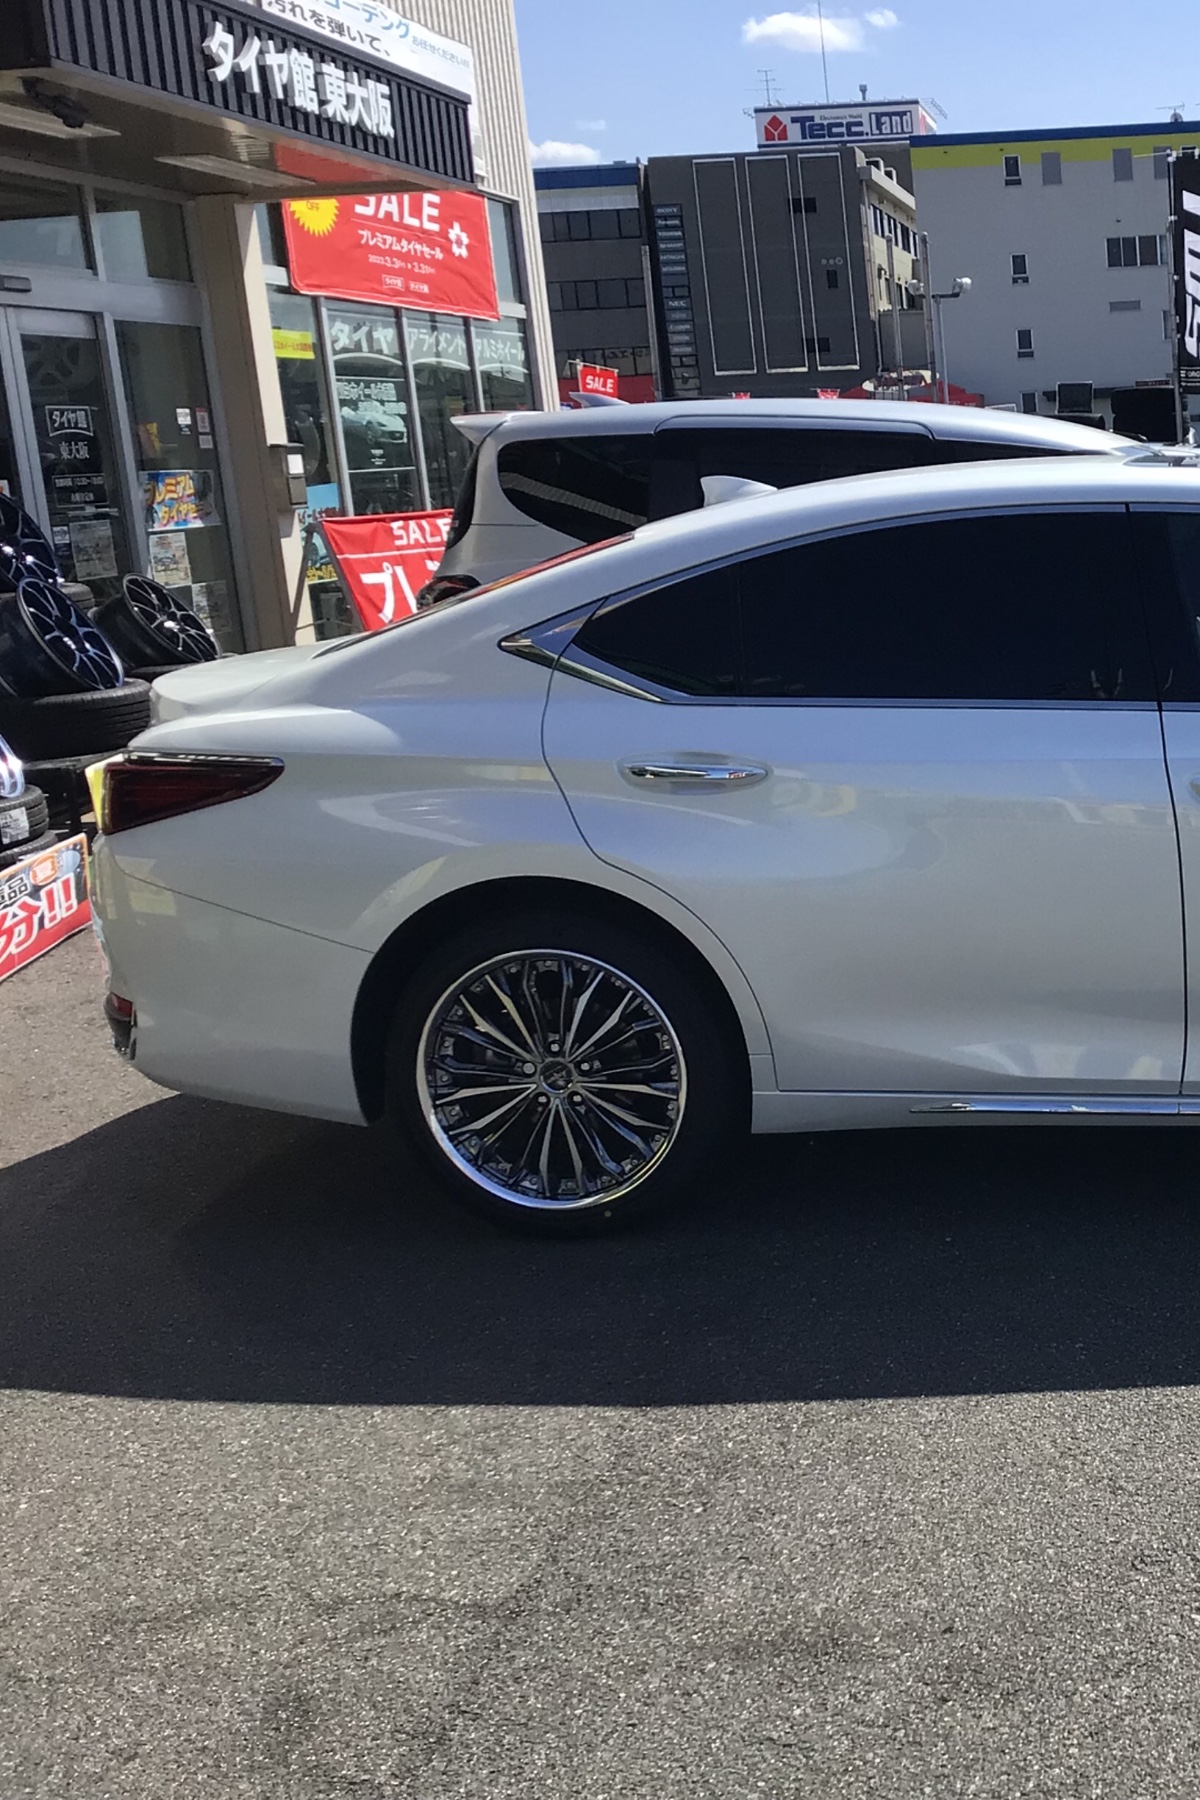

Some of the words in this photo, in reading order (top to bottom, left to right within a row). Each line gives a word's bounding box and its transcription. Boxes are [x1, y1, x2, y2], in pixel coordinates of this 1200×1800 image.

[202, 21, 319, 115] タイヤ館
[321, 60, 395, 139] 東大阪
[330, 320, 395, 355] タイヤ
[585, 375, 615, 393] SALE
[52, 410, 88, 428] タイヤ館
[59, 441, 90, 460] 東大阪
